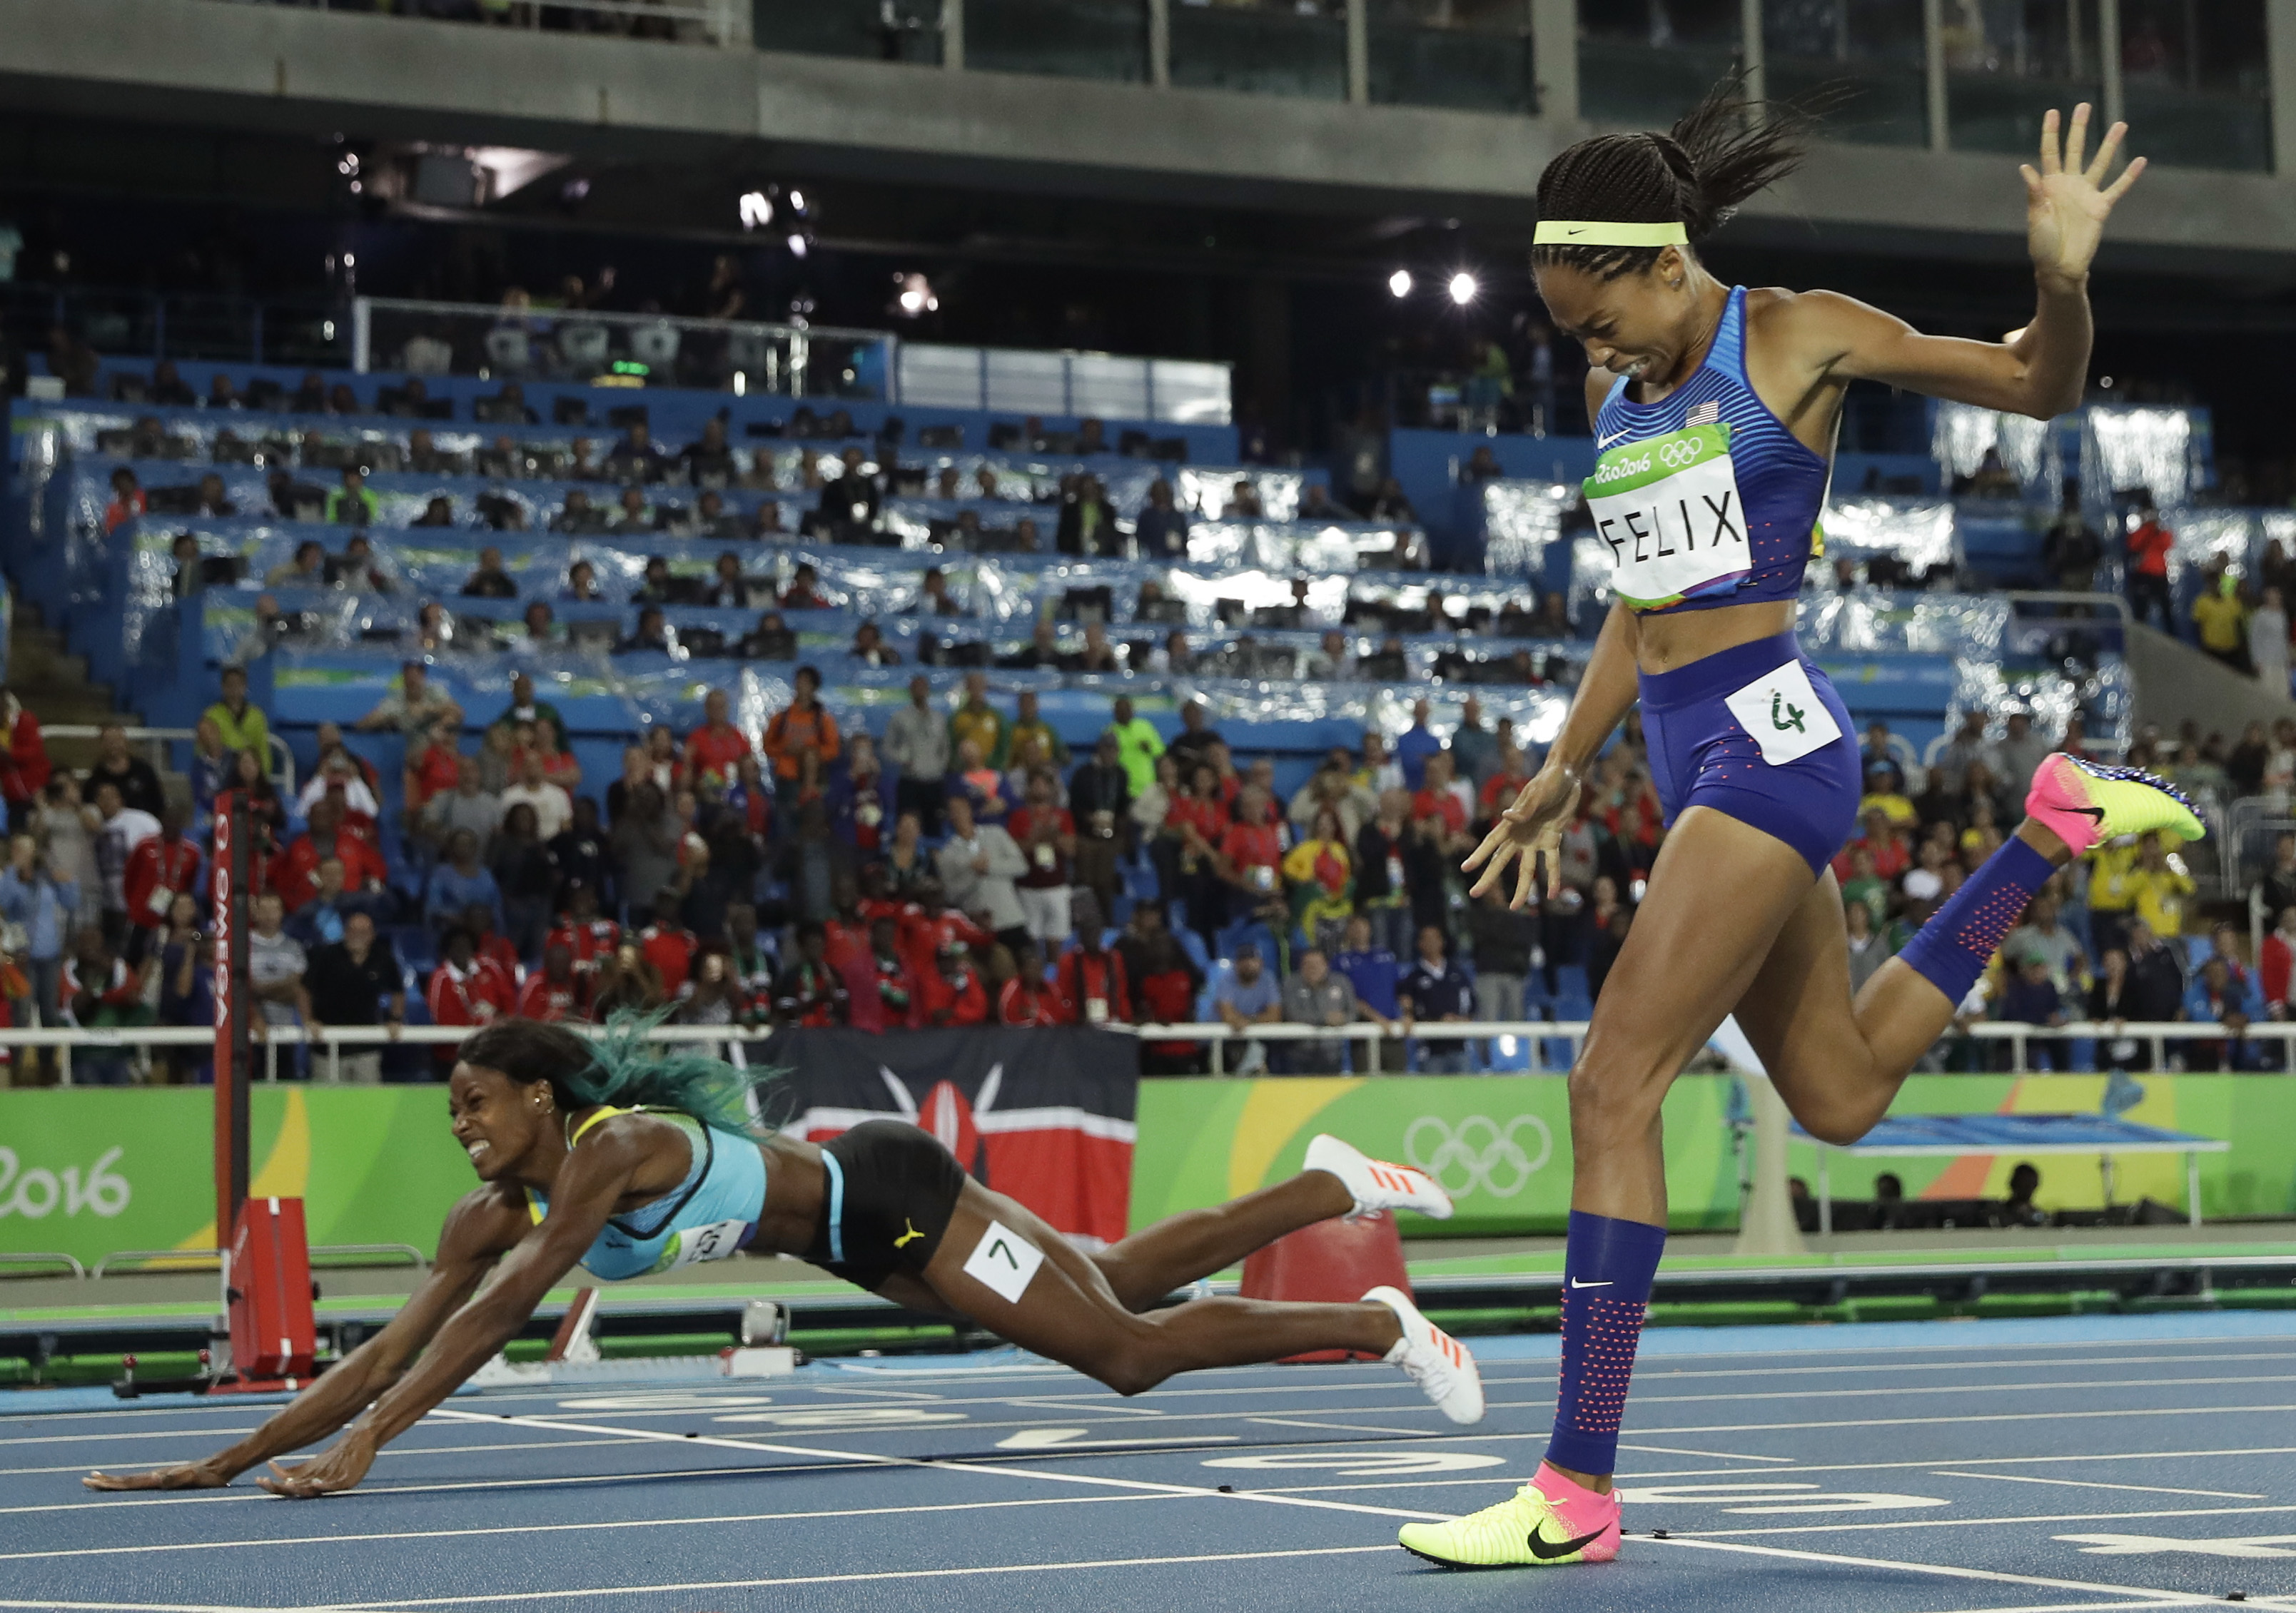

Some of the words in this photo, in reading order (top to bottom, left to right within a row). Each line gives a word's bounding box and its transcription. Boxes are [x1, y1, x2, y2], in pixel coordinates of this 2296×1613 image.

[1599, 491, 1742, 568] FELIX
[1771, 692, 1806, 734] 4
[216, 866, 229, 1028] OMEGA
[988, 1238, 1018, 1270] 7
